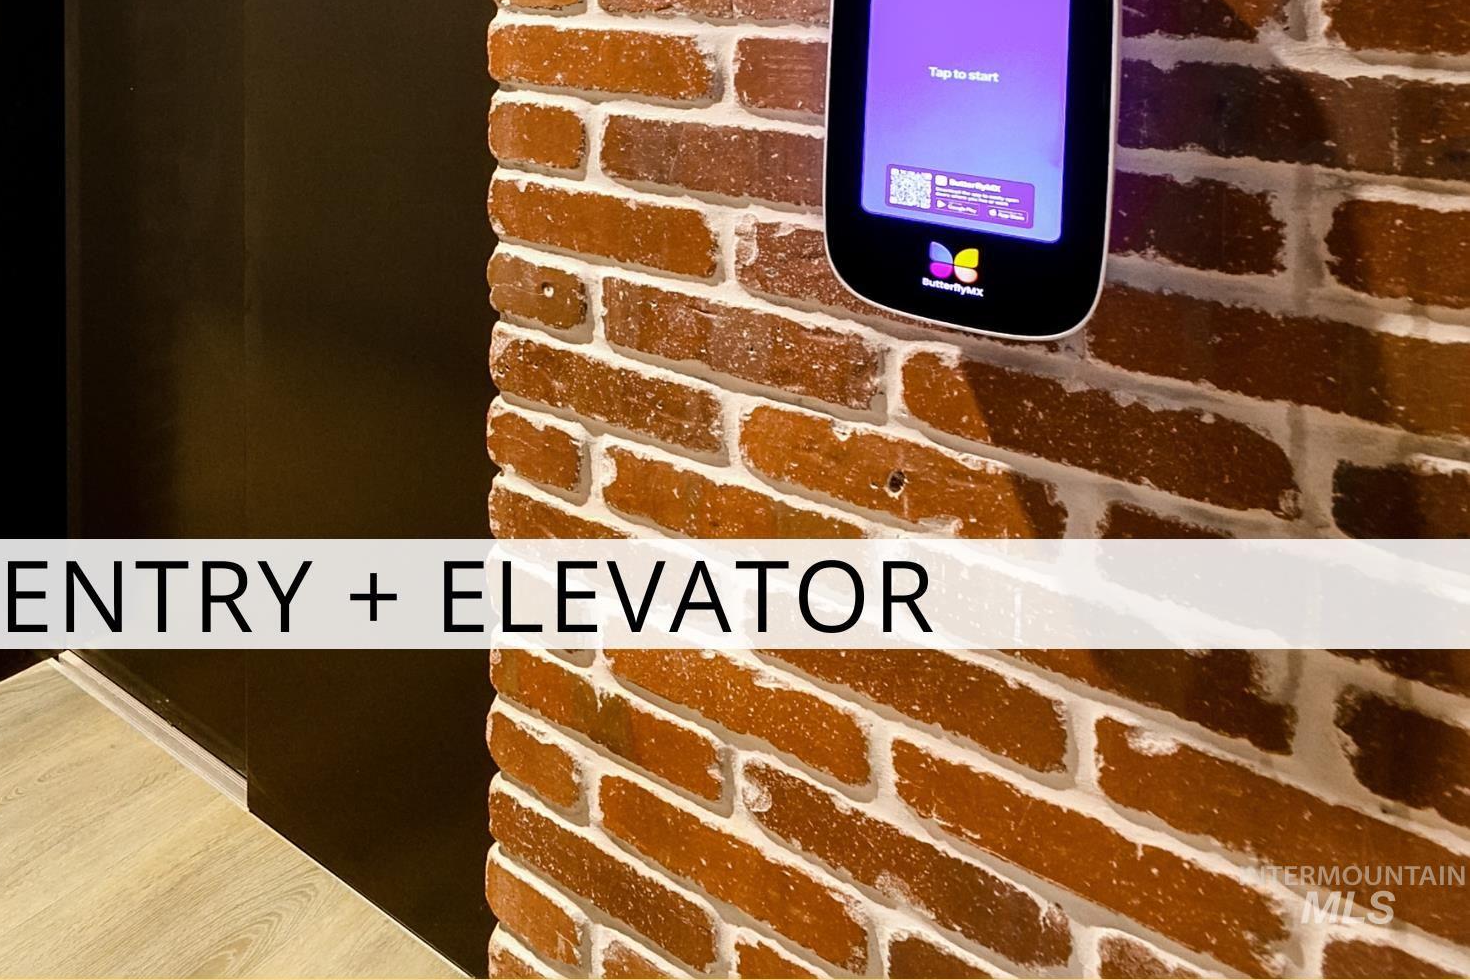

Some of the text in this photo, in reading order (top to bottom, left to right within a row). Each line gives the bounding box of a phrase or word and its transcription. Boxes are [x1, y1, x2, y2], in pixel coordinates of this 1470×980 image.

[928, 66, 999, 83] Tap to start
[949, 178, 1001, 192] ButterflyMX
[948, 203, 965, 213] Google
[965, 206, 977, 214] Play
[921, 277, 984, 297] ButterflyMX
